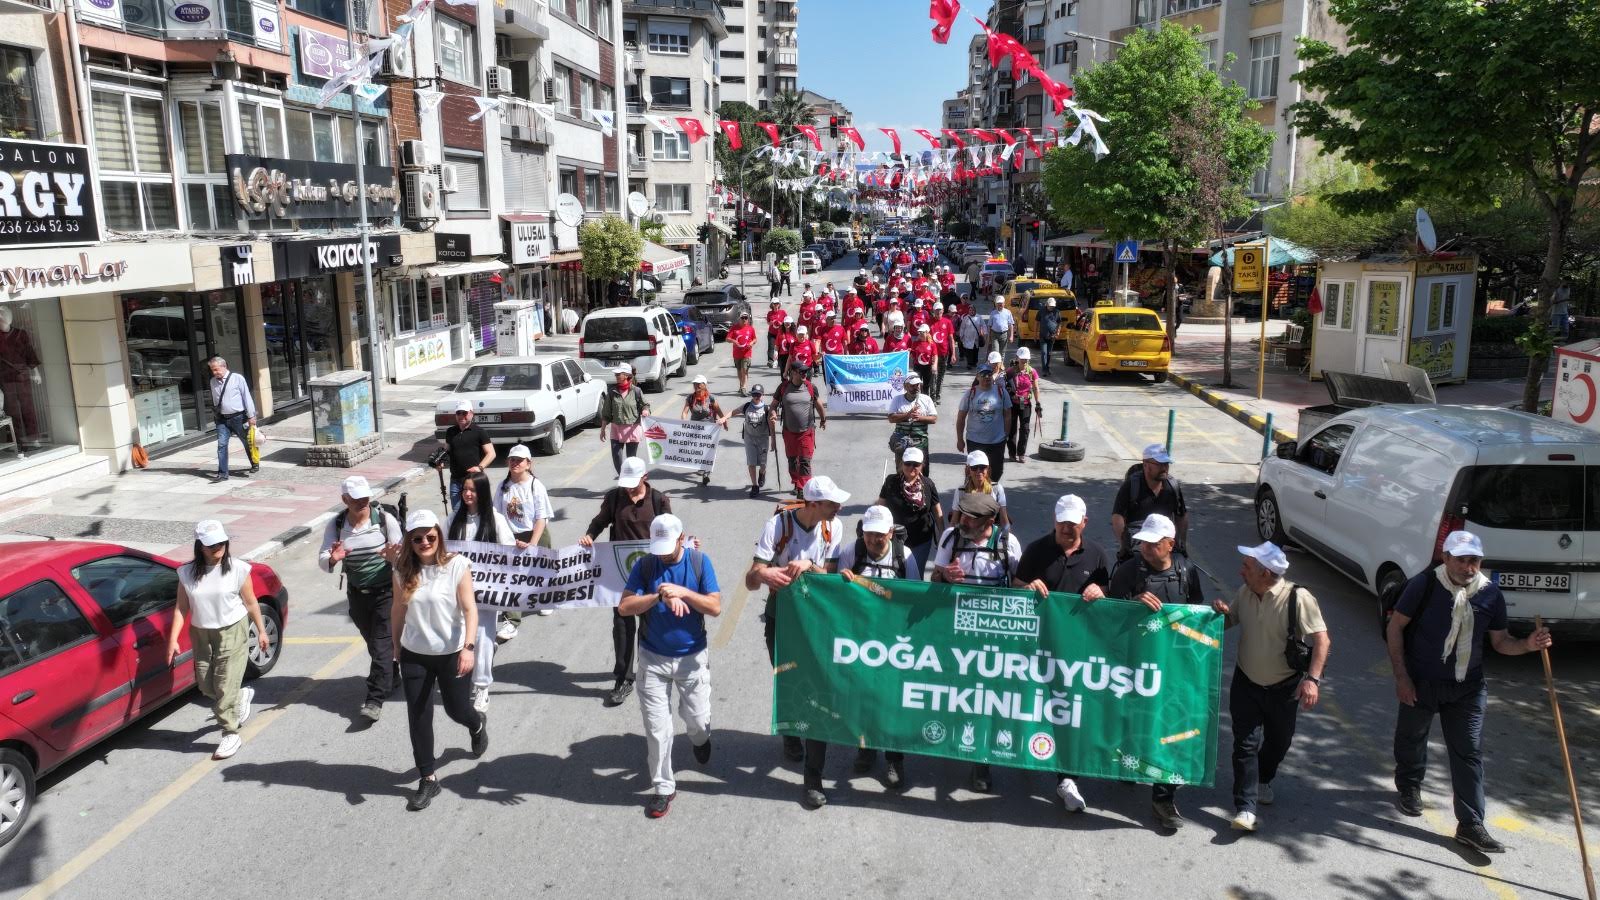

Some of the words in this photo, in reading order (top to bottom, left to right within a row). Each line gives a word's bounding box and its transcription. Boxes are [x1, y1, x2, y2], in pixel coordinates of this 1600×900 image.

[25, 221, 47, 233] 234
[49, 220, 63, 232] 52
[66, 220, 80, 232] 53
[517, 224, 547, 241] ULUSAL
[318, 241, 378, 268] karaca
[526, 244, 541, 257] GSM
[512, 552, 592, 573] BÜYÜKŞEHİR
[510, 573, 545, 588] SPOR
[548, 565, 602, 588] KULÜBÜ
[1499, 574, 1515, 586] 35
[1518, 575, 1542, 587] BLP
[1545, 576, 1568, 588] 948
[526, 580, 595, 609] ŞUBESİ
[961, 597, 1000, 611] MESİR
[978, 616, 1036, 632] MACUNU
[832, 635, 943, 674] DOĞA
[950, 644, 1163, 700] YÜRÜYÜŞÜ
[901, 680, 1083, 729] ETKİNLİĞİ
